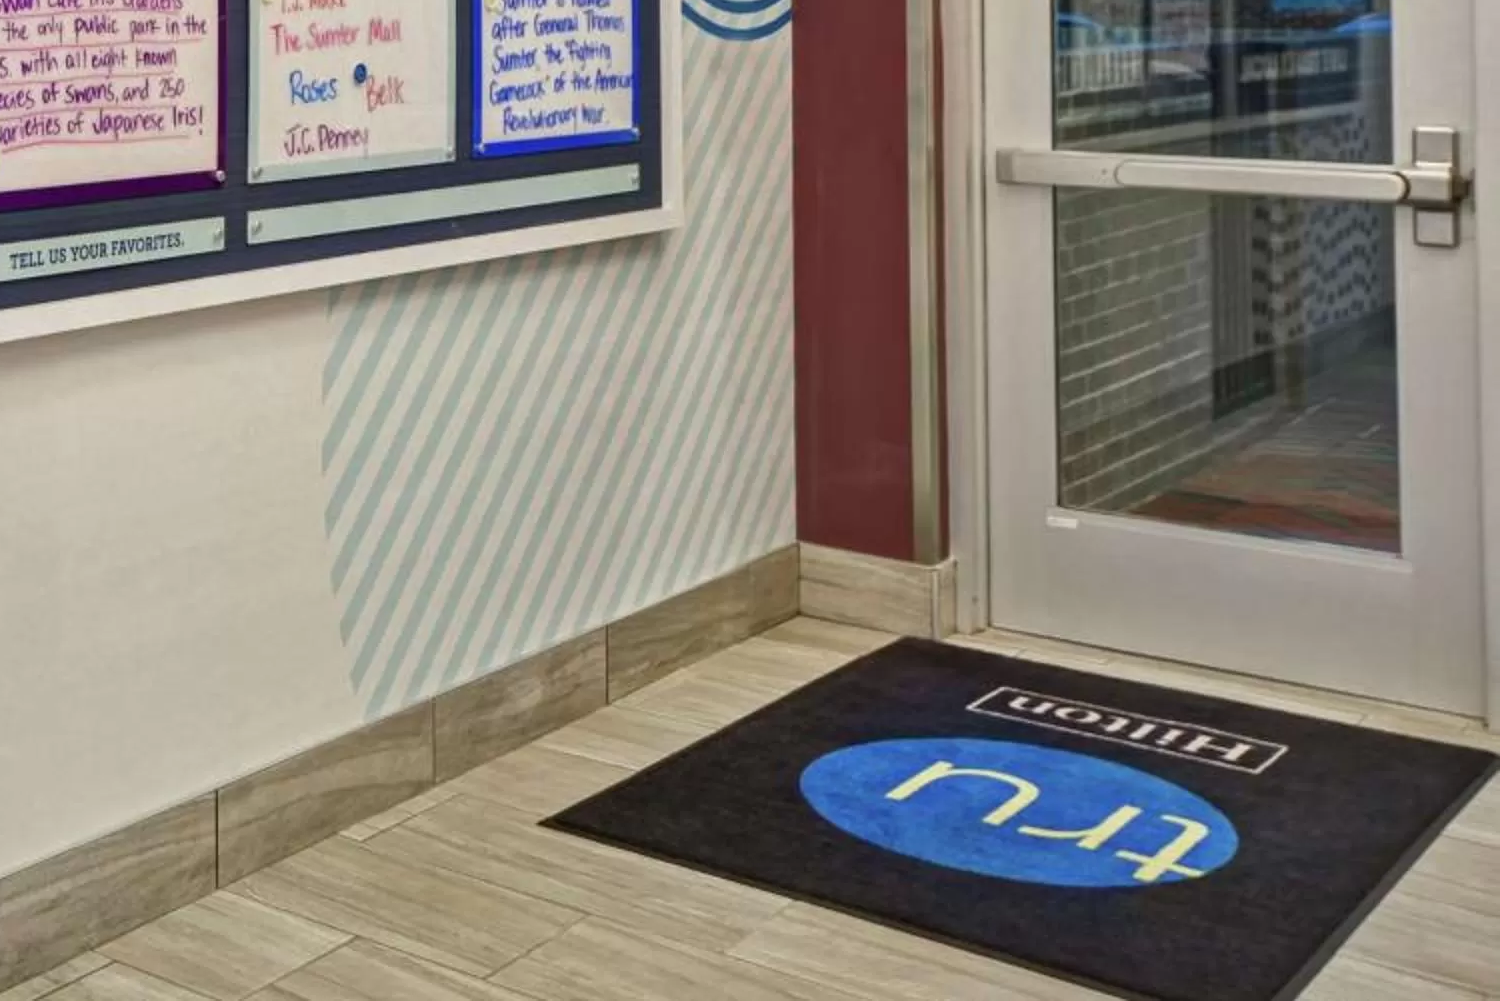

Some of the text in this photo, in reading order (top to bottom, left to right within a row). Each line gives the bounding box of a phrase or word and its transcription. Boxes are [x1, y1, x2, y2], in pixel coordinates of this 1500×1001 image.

[1, 18, 29, 43] the
[37, 17, 64, 44] only
[73, 15, 120, 43] public
[129, 17, 161, 41] park
[165, 16, 181, 35] in
[183, 14, 208, 36] the
[269, 21, 302, 56] The
[367, 15, 404, 46] Mall
[491, 15, 528, 42] after
[20, 52, 59, 76] with
[65, 49, 88, 69] all
[91, 47, 127, 79] eight
[135, 48, 178, 67] known
[42, 80, 58, 104] of
[123, 77, 150, 101] and
[158, 77, 185, 99] 250
[289, 69, 339, 106] Roses
[366, 74, 406, 113] Belk
[553, 70, 567, 93] of
[67, 109, 86, 135] of
[92, 106, 165, 142] Japanese
[317, 123, 370, 159] Penney
[9, 231, 185, 271] TELL US YOUR FAVORITES.
[1007, 696, 1257, 763] Hilton
[884, 760, 1209, 884] tru
